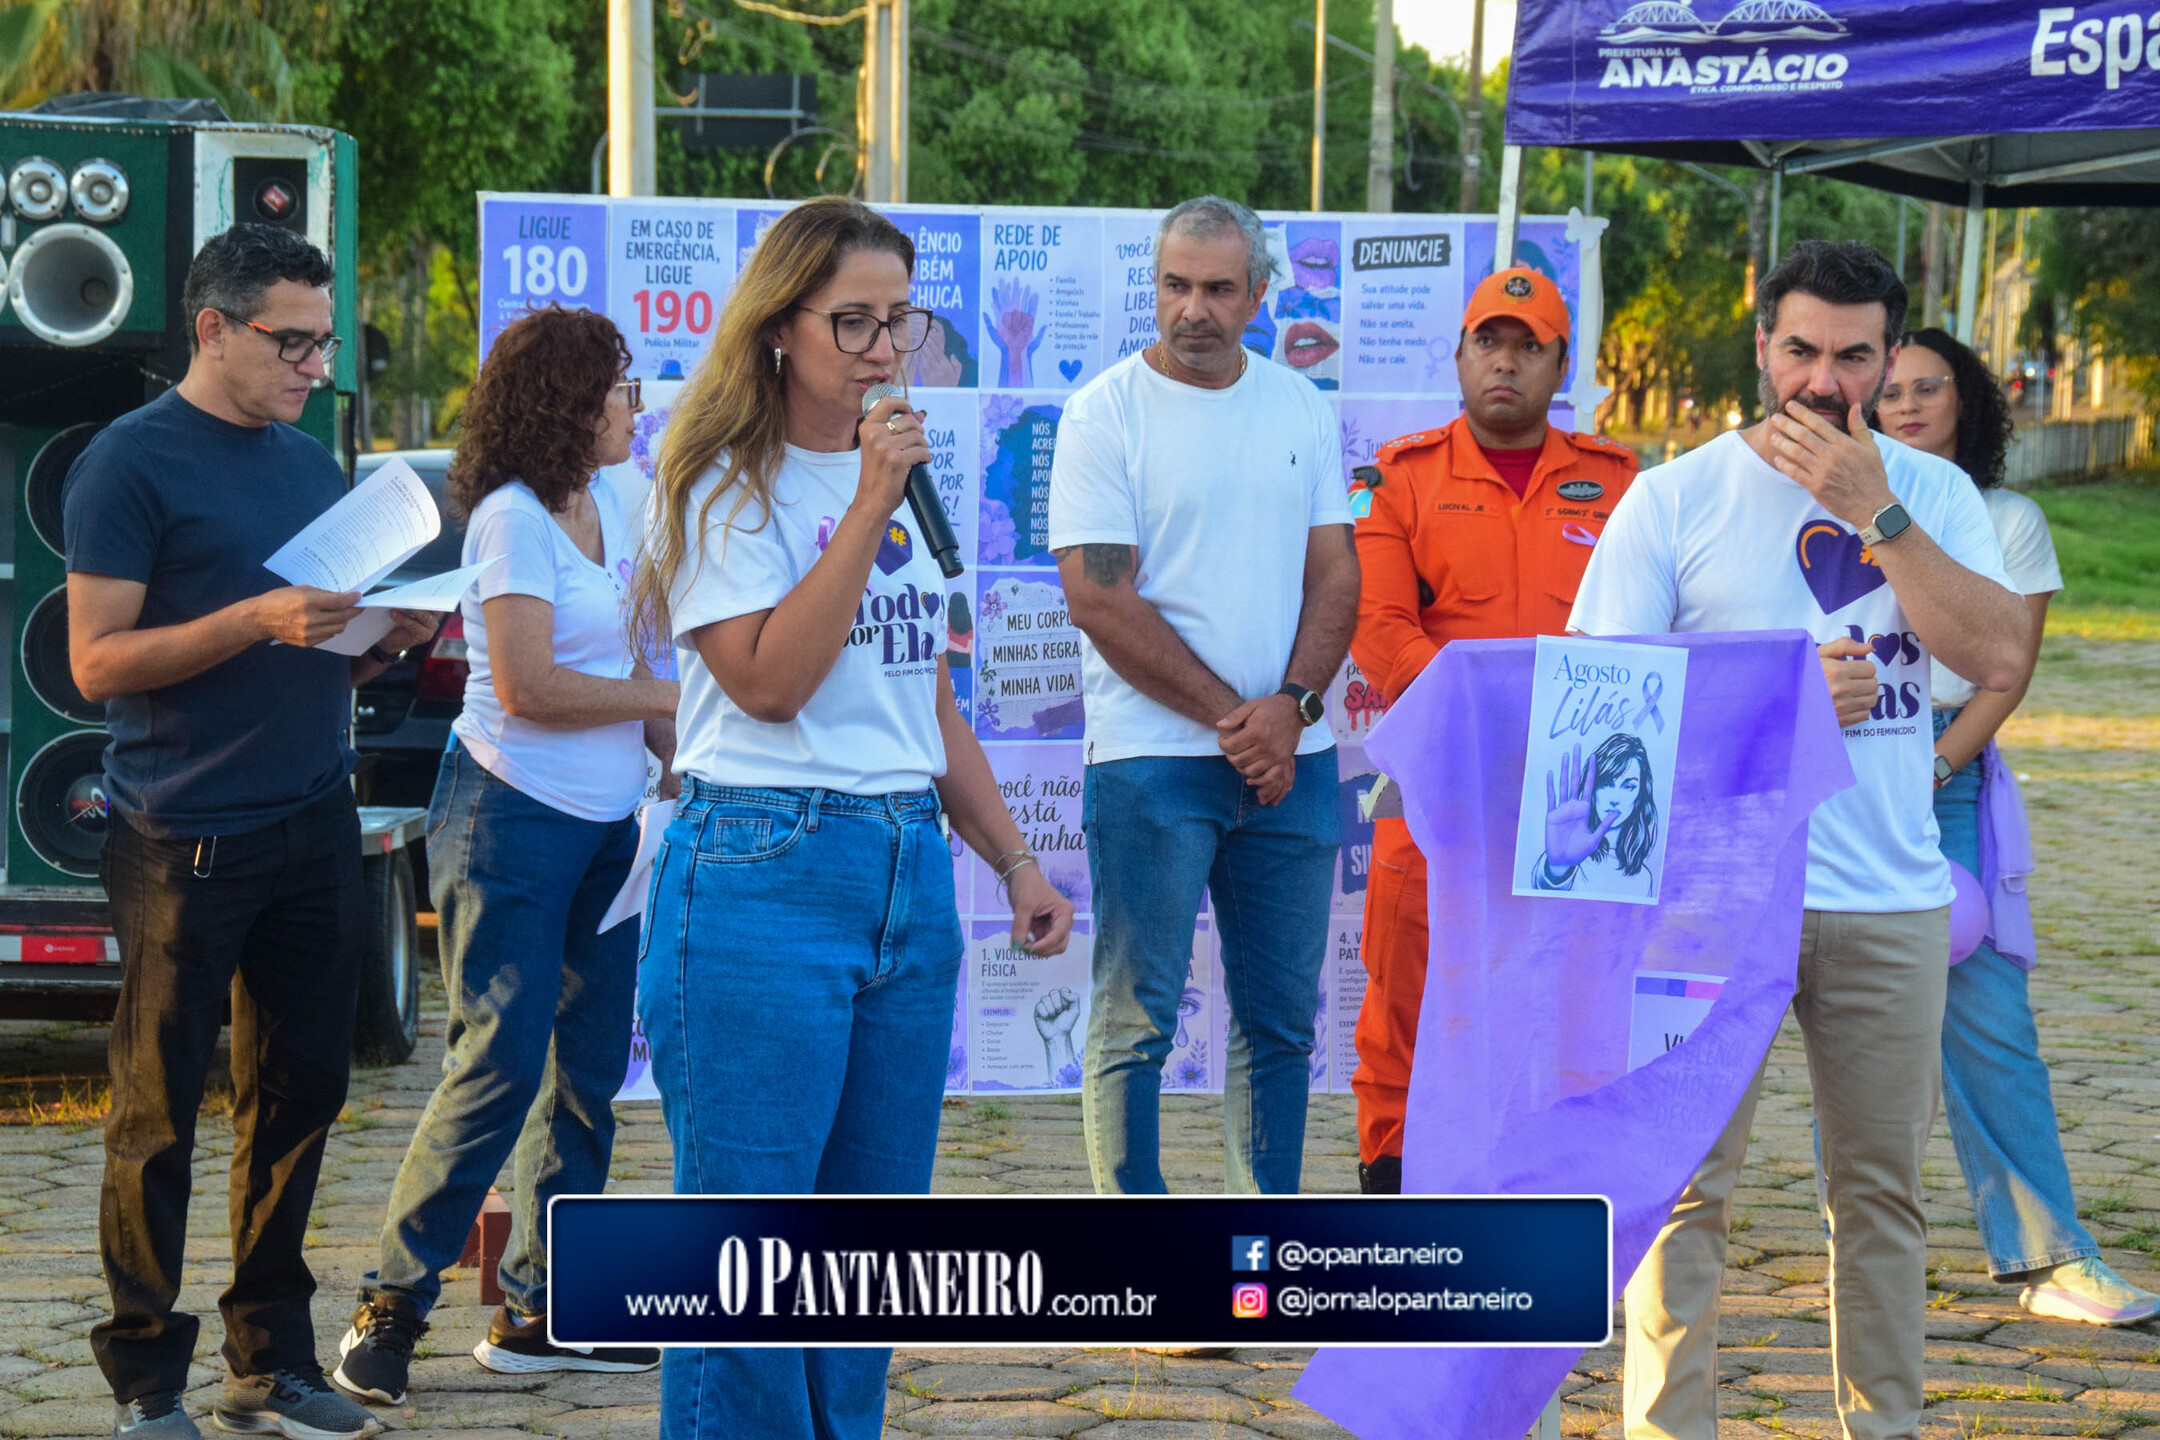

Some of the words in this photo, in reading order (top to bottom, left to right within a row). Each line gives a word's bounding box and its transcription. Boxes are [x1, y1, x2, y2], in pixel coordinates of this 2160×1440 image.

[1599, 48, 1665, 57] PREFEITURA
[1666, 48, 1681, 56] DE
[1599, 47, 1849, 88] ANASTÁCIO
[1720, 83, 1788, 93] COMPROMISSO
[1790, 83, 1796, 91] E
[1798, 81, 1843, 91] RESPEITO
[519, 215, 571, 239] LIGUE
[631, 219, 651, 237] EM
[655, 220, 692, 239] CASO
[698, 221, 714, 239] DE
[994, 224, 1034, 246] REDE
[1042, 225, 1062, 246] DE
[626, 240, 720, 263] EMERGÊNCIA,
[994, 249, 1048, 272] APOIO
[1359, 239, 1444, 266] DENUNCIE
[503, 245, 588, 296] 180
[645, 265, 692, 285] LIGUE
[1127, 267, 1154, 287] RES
[1361, 283, 1377, 294] Sua
[1380, 283, 1408, 294] atitude
[1411, 284, 1431, 296] pode
[633, 289, 713, 334] 190
[1361, 300, 1384, 310] salvar
[1388, 302, 1405, 310] uma
[1360, 319, 1376, 329] Não
[1379, 321, 1388, 329] se
[673, 337, 700, 348] Militar
[1359, 336, 1376, 346] Não
[1379, 336, 1401, 346] tenha
[1358, 354, 1376, 364] Não
[1378, 356, 1387, 364] se
[1032, 420, 1050, 436] NÓS
[928, 429, 956, 449] SUA
[1032, 452, 1050, 467] NÓS
[939, 473, 964, 491] POR
[1031, 484, 1049, 499] NÓS
[1438, 503, 1471, 511] LUCIVAL
[1031, 515, 1048, 530] NÓS
[1007, 613, 1031, 631] MEU
[843, 625, 880, 648] or
[993, 643, 1038, 663] MINHAS
[1043, 641, 1082, 660] REGRA
[1554, 654, 1630, 689] Agosto
[1001, 677, 1041, 697] MINHA
[1046, 673, 1075, 692] VIDA
[1549, 686, 1636, 739] Lilás
[1845, 728, 1862, 738] FIM
[1863, 728, 1876, 737] DO
[1041, 775, 1083, 798] não
[1339, 932, 1351, 945] 4.
[981, 948, 990, 960] 1.
[981, 961, 1017, 977] FÍSICA
